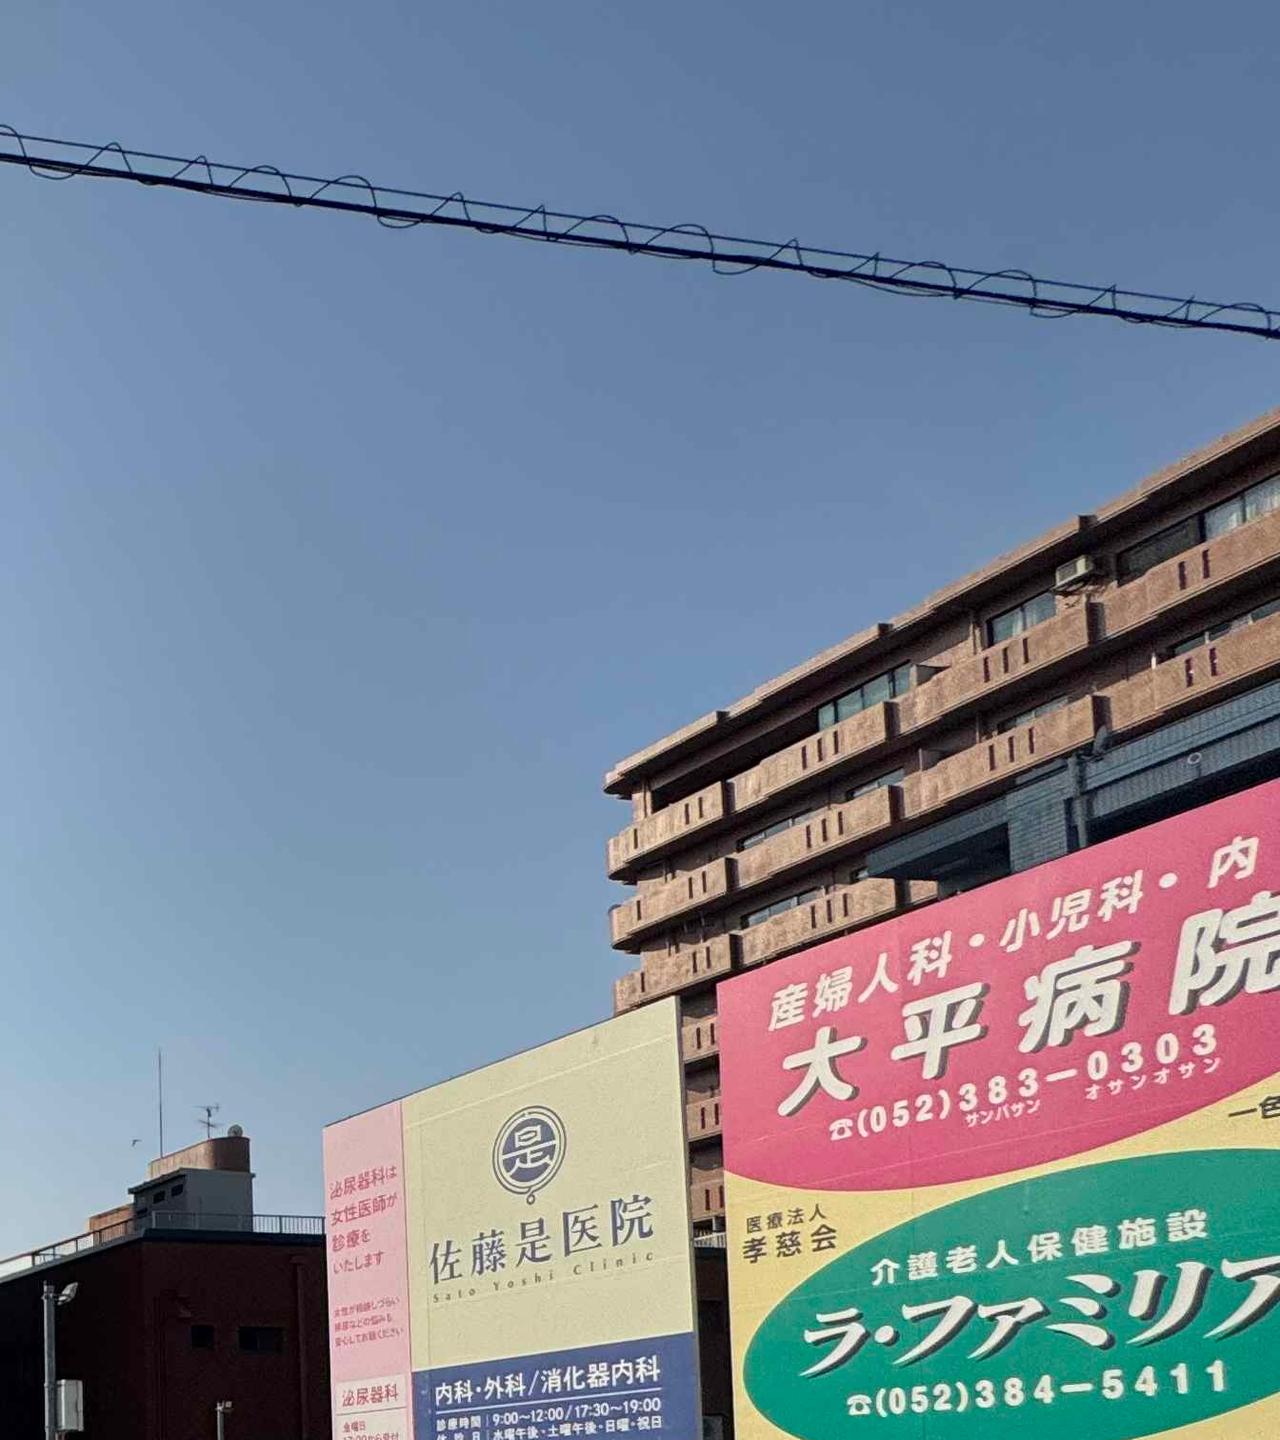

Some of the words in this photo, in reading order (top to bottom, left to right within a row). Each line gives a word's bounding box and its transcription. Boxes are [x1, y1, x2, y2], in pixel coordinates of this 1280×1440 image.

[777, 889, 1280, 1117] 大平病院
[330, 1166, 397, 1200] 泌尿器科は
[331, 1193, 398, 1226] 女性医師が
[746, 1203, 827, 1234] 医療法人
[332, 1229, 371, 1252] 診療を
[429, 1194, 655, 1285] 佐藤是医院
[742, 1223, 838, 1264] 孝慈会
[871, 1208, 1209, 1287] 介護老人保健施設
[333, 1251, 384, 1274] いたします
[433, 1287, 477, 1303] Sato
[493, 1269, 555, 1291] Yoshi
[572, 1251, 654, 1275] Clinic
[799, 1256, 1280, 1380] ラ・ファミリア
[342, 1384, 398, 1407] 泌尿器科
[437, 1416, 482, 1431] 診療時間
